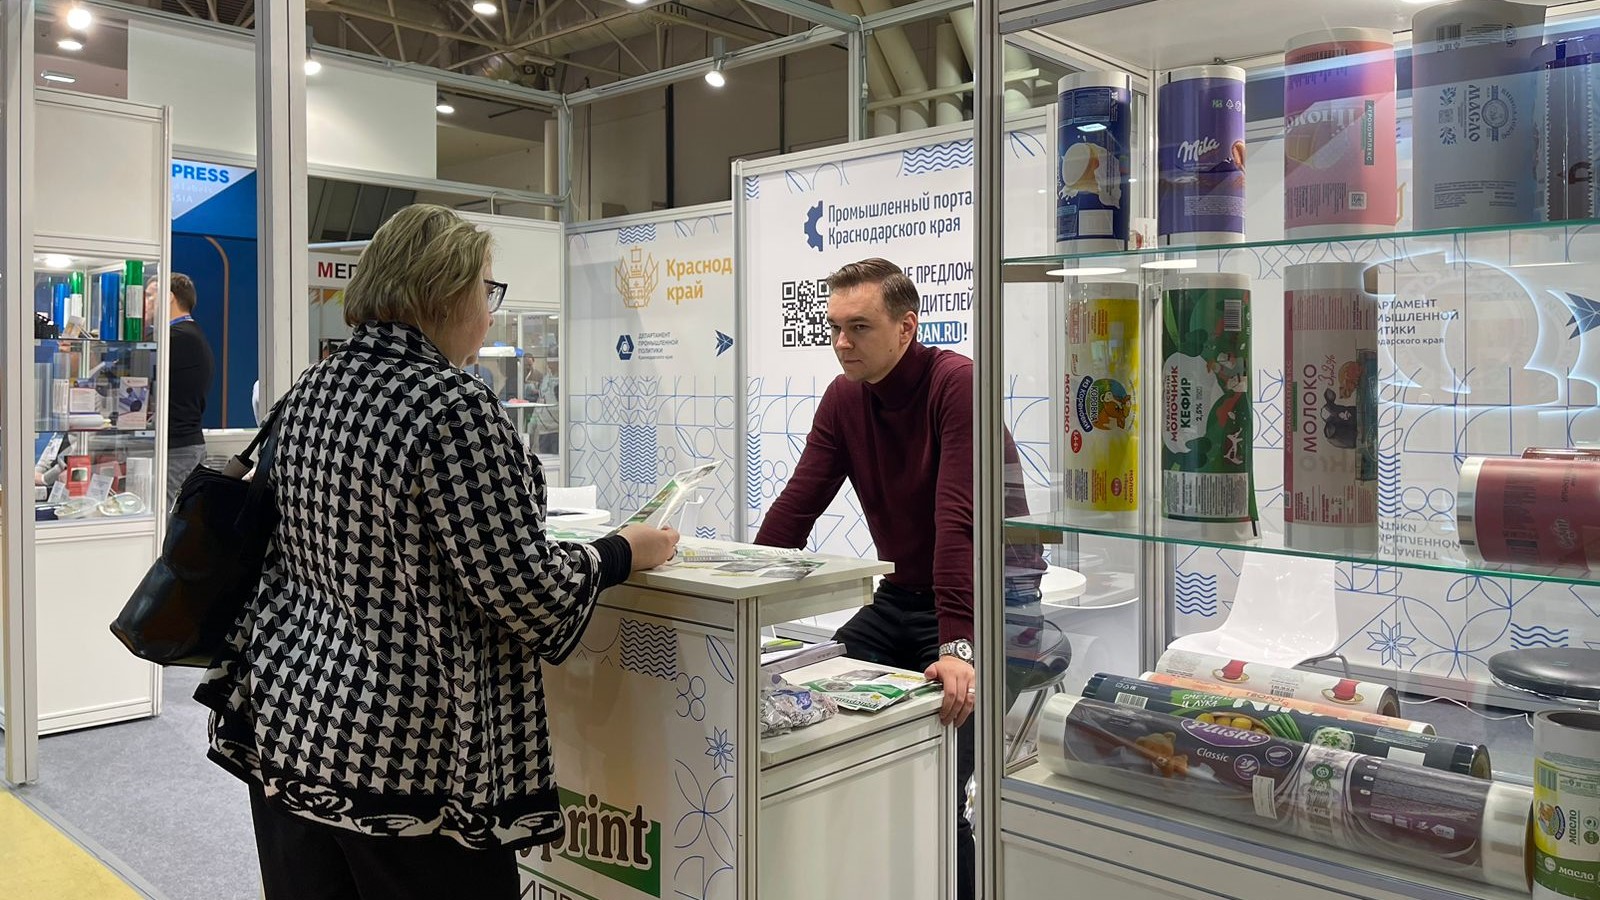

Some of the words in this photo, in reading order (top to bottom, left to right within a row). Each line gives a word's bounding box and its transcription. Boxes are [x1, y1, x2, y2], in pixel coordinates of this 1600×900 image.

[1468, 85, 1481, 142] МАСЛО
[172, 164, 230, 184] PRESS
[828, 191, 930, 226] Промышленный
[934, 190, 973, 212] порта
[828, 221, 926, 249] Краснодарского
[929, 217, 960, 238] края
[666, 257, 733, 281] Краснод
[666, 280, 703, 305] край
[1170, 365, 1178, 442] МОЛОЧНИК
[1180, 377, 1191, 428] КЕФИР
[1303, 364, 1317, 453] МОЛОКО
[1196, 747, 1230, 762] Classic
[1559, 866, 1595, 881] масло
